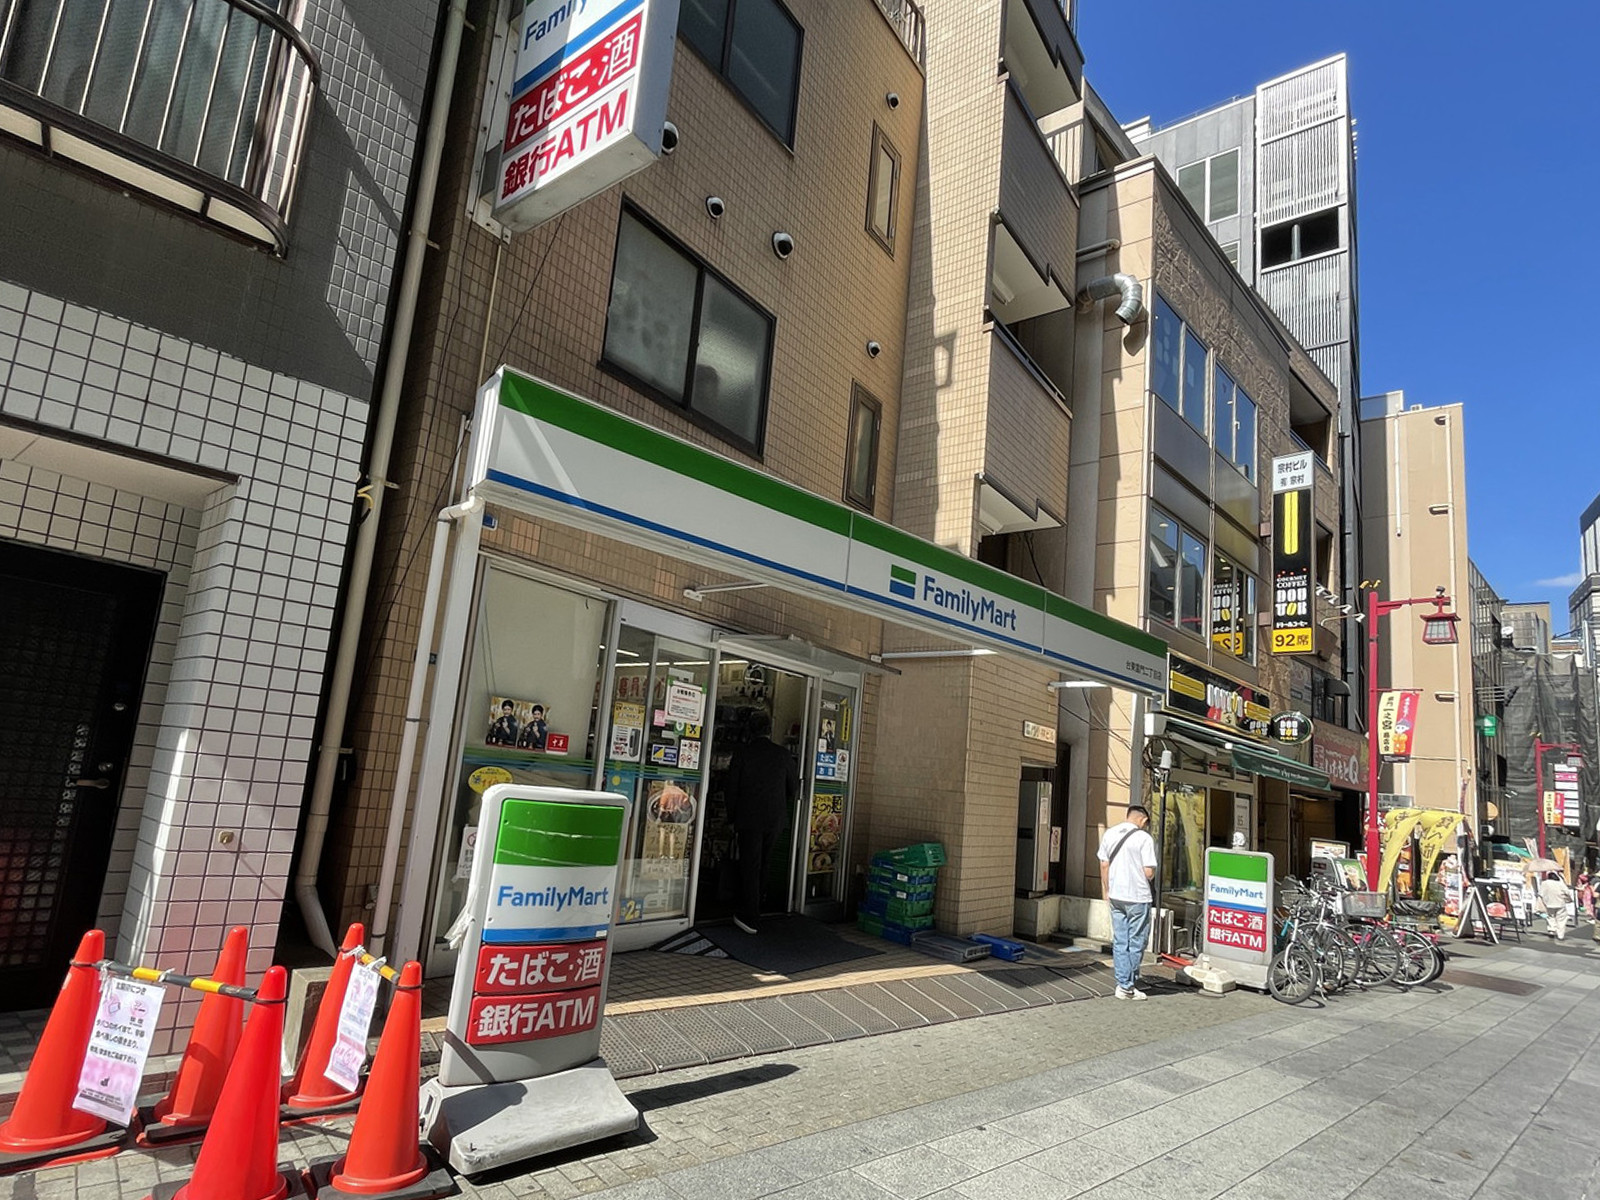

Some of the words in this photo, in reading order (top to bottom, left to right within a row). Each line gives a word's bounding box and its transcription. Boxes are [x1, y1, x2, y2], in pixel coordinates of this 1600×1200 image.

[501, 89, 629, 200] 銀行ATM
[1276, 580, 1307, 588] COFFEE
[923, 575, 1017, 632] FamilyMart
[497, 886, 609, 912] FamilyMart
[1210, 883, 1264, 900] FamilyMart
[1209, 927, 1263, 949] 銀行ATM
[477, 995, 596, 1037] 銀行ATM
